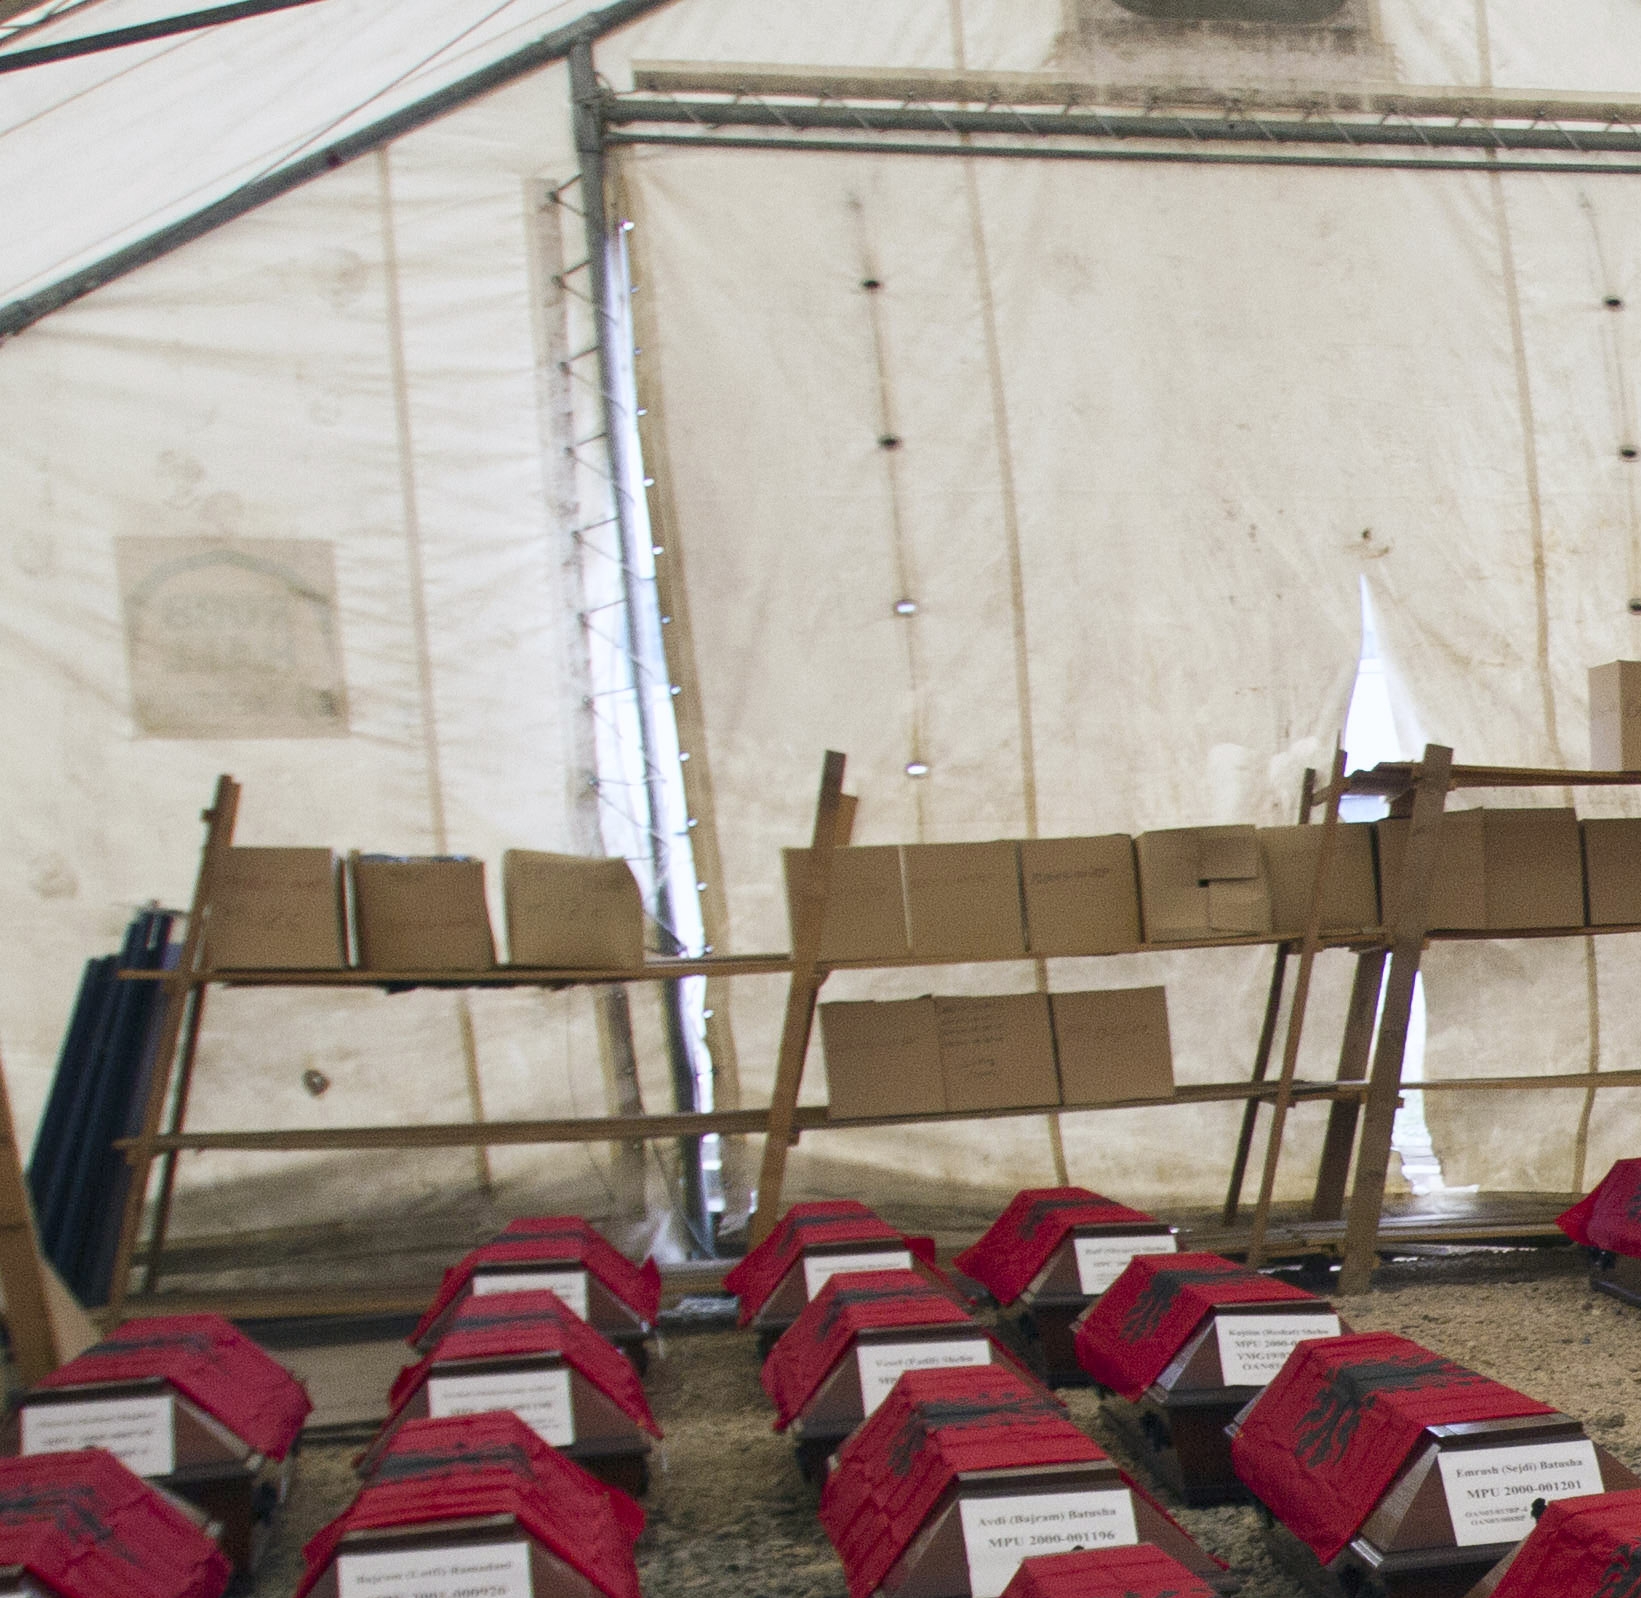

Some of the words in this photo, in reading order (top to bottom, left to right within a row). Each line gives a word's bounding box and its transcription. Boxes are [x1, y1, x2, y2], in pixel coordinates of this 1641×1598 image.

[1456, 1466, 1499, 1479] Emrush
[1501, 1461, 1538, 1475] (Sejdi)
[1540, 1457, 1584, 1470] Batusha
[1466, 1486, 1502, 1500] MPU
[1504, 1479, 1583, 1497] 2000-001201
[977, 1514, 1007, 1528] Avdi
[1008, 1511, 1065, 1526] (Bajram)
[1067, 1507, 1117, 1520] Batusha
[988, 1536, 1025, 1549] MPU
